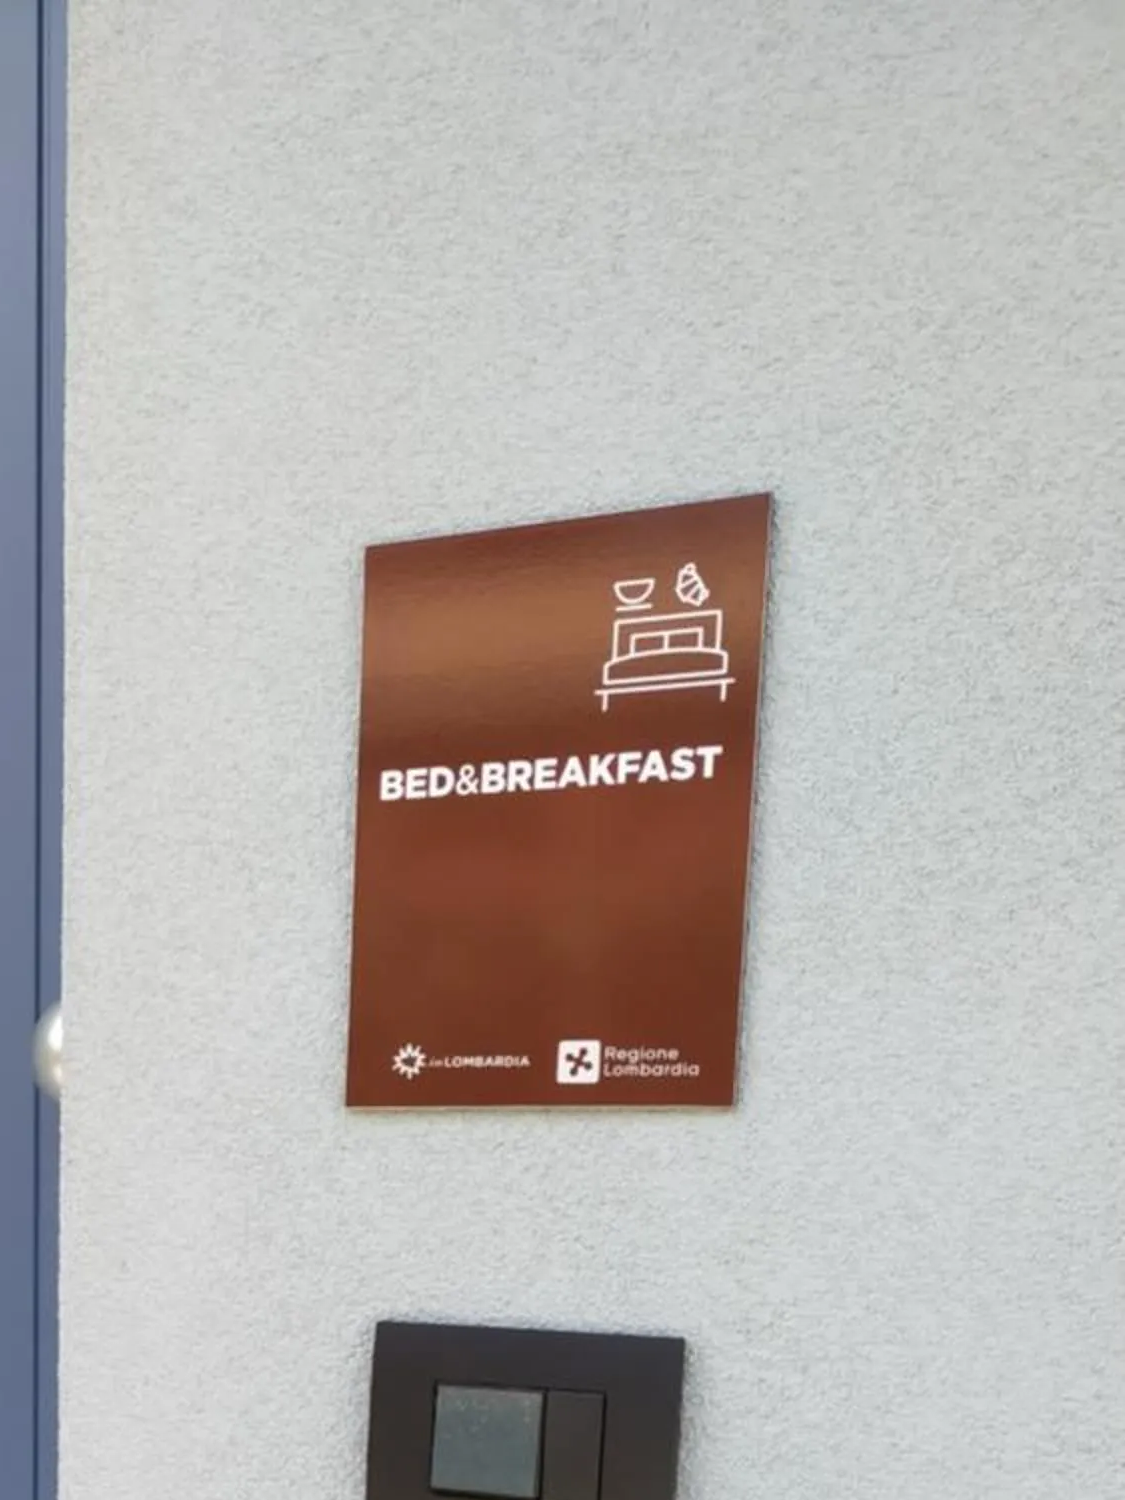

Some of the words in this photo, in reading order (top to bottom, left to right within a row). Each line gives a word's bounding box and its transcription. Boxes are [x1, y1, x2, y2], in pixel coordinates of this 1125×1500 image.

[379, 745, 723, 801] BED&BREAKFAST
[604, 1045, 680, 1064] Regione
[603, 1062, 700, 1077] Lombardia
